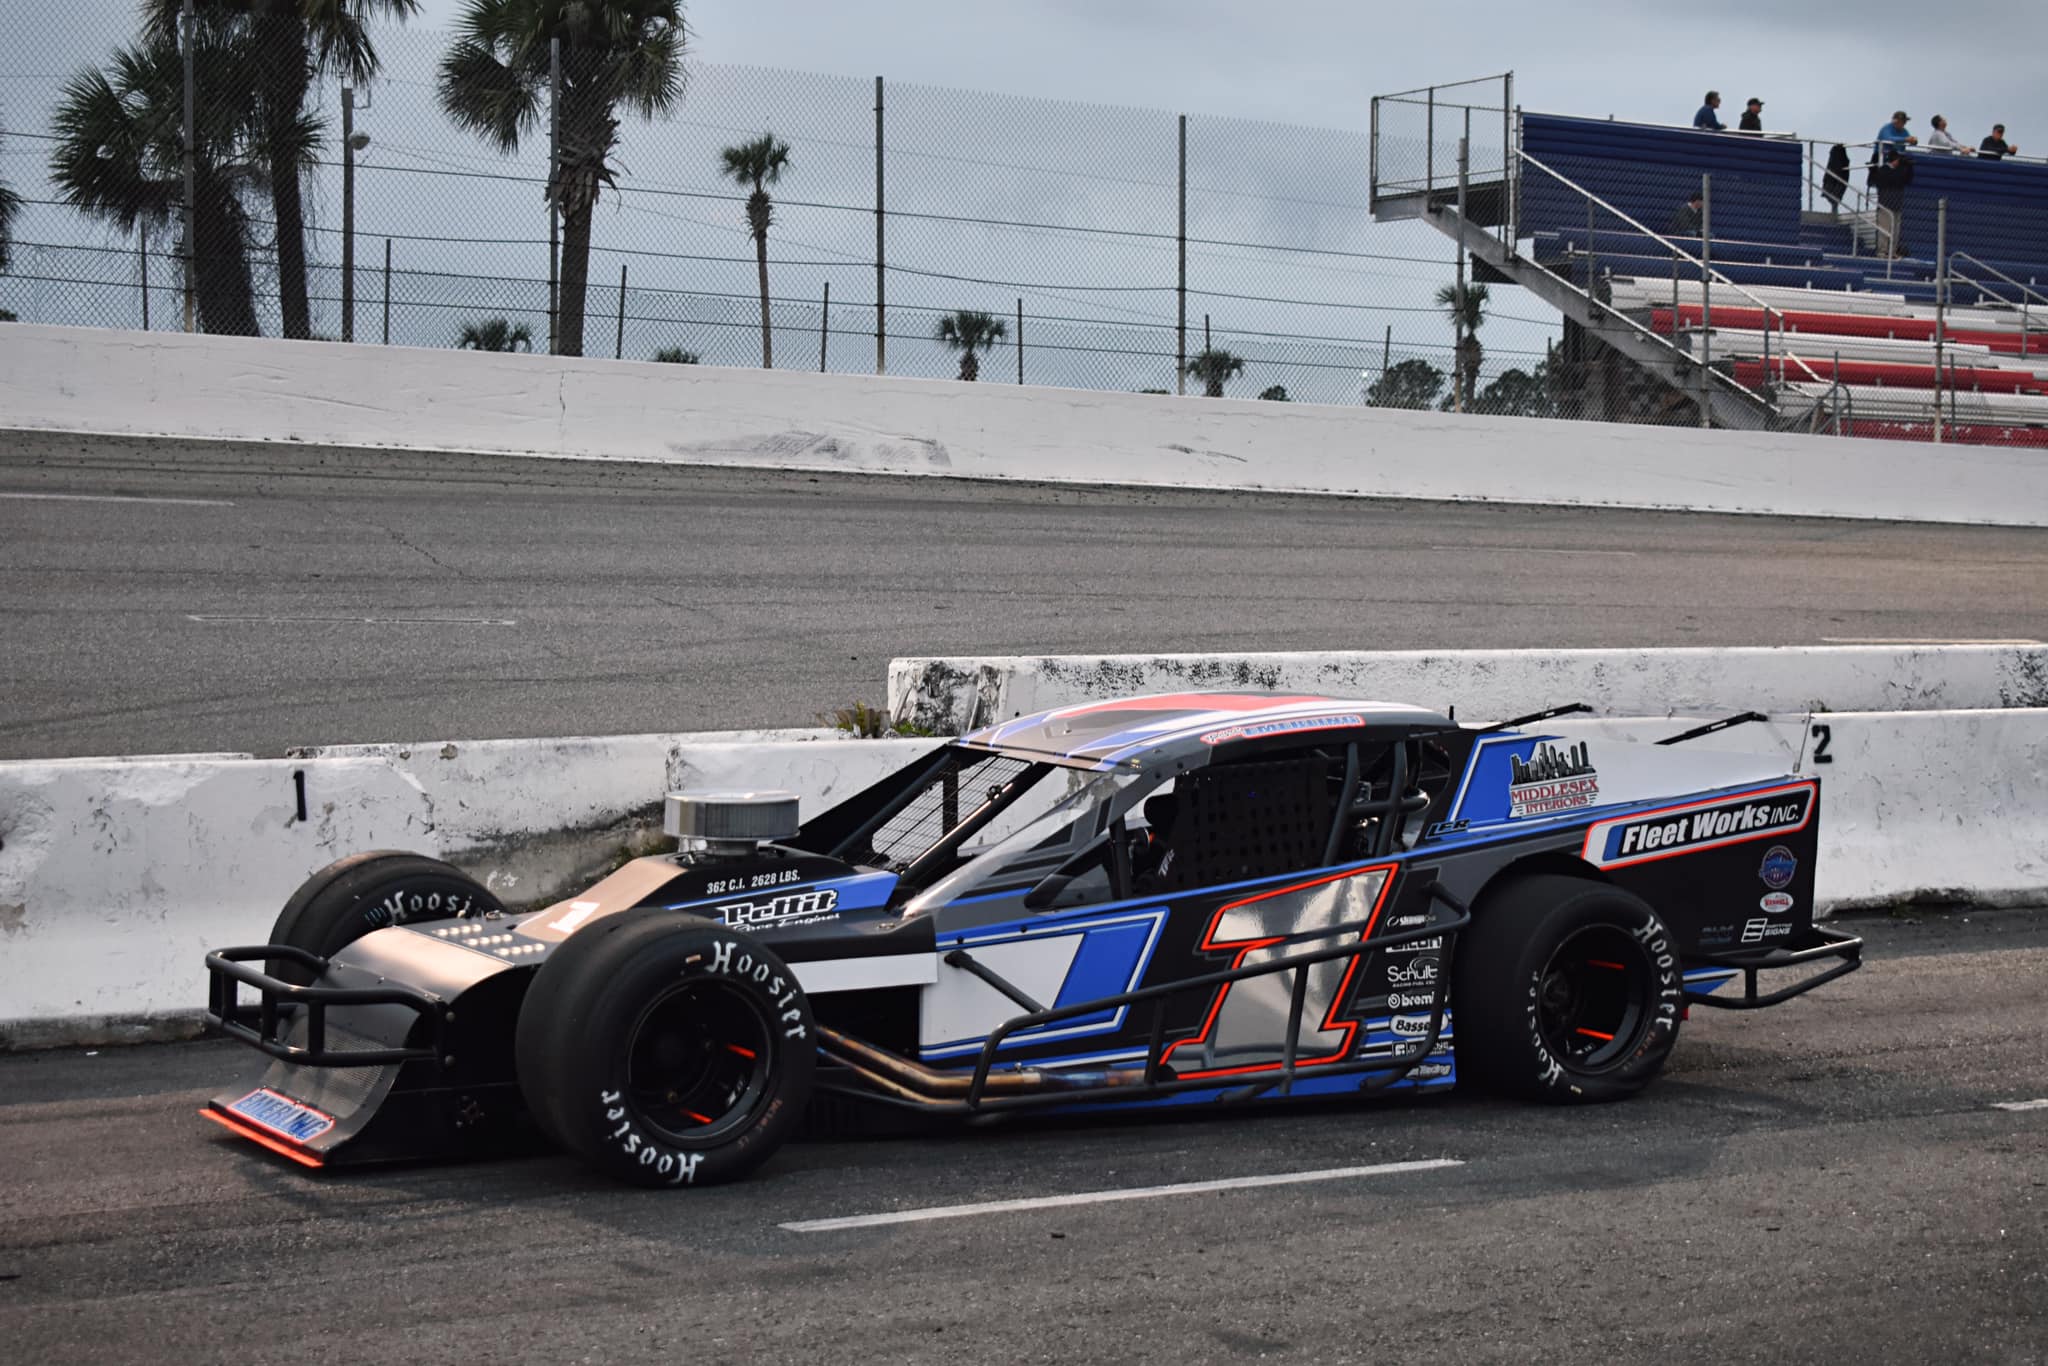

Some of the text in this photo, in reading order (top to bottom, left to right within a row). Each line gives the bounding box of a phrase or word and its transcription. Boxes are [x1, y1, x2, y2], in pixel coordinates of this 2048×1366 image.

[1811, 724, 1833, 764] 2
[293, 769, 307, 822] 1
[1511, 778, 1599, 804] MIDDLESEX
[1526, 795, 1588, 815] INTERIORS
[1621, 803, 1800, 854] Fleet Works INC.
[706, 869, 802, 895] 362 C.I. 2628 LBS.
[384, 889, 475, 926] Hoosi
[547, 901, 602, 934] 1
[704, 940, 807, 1039] Hoosier
[1158, 862, 1400, 1081] 1
[1632, 914, 1682, 1032] Hoosier
[600, 1089, 705, 1184] Hoosier
